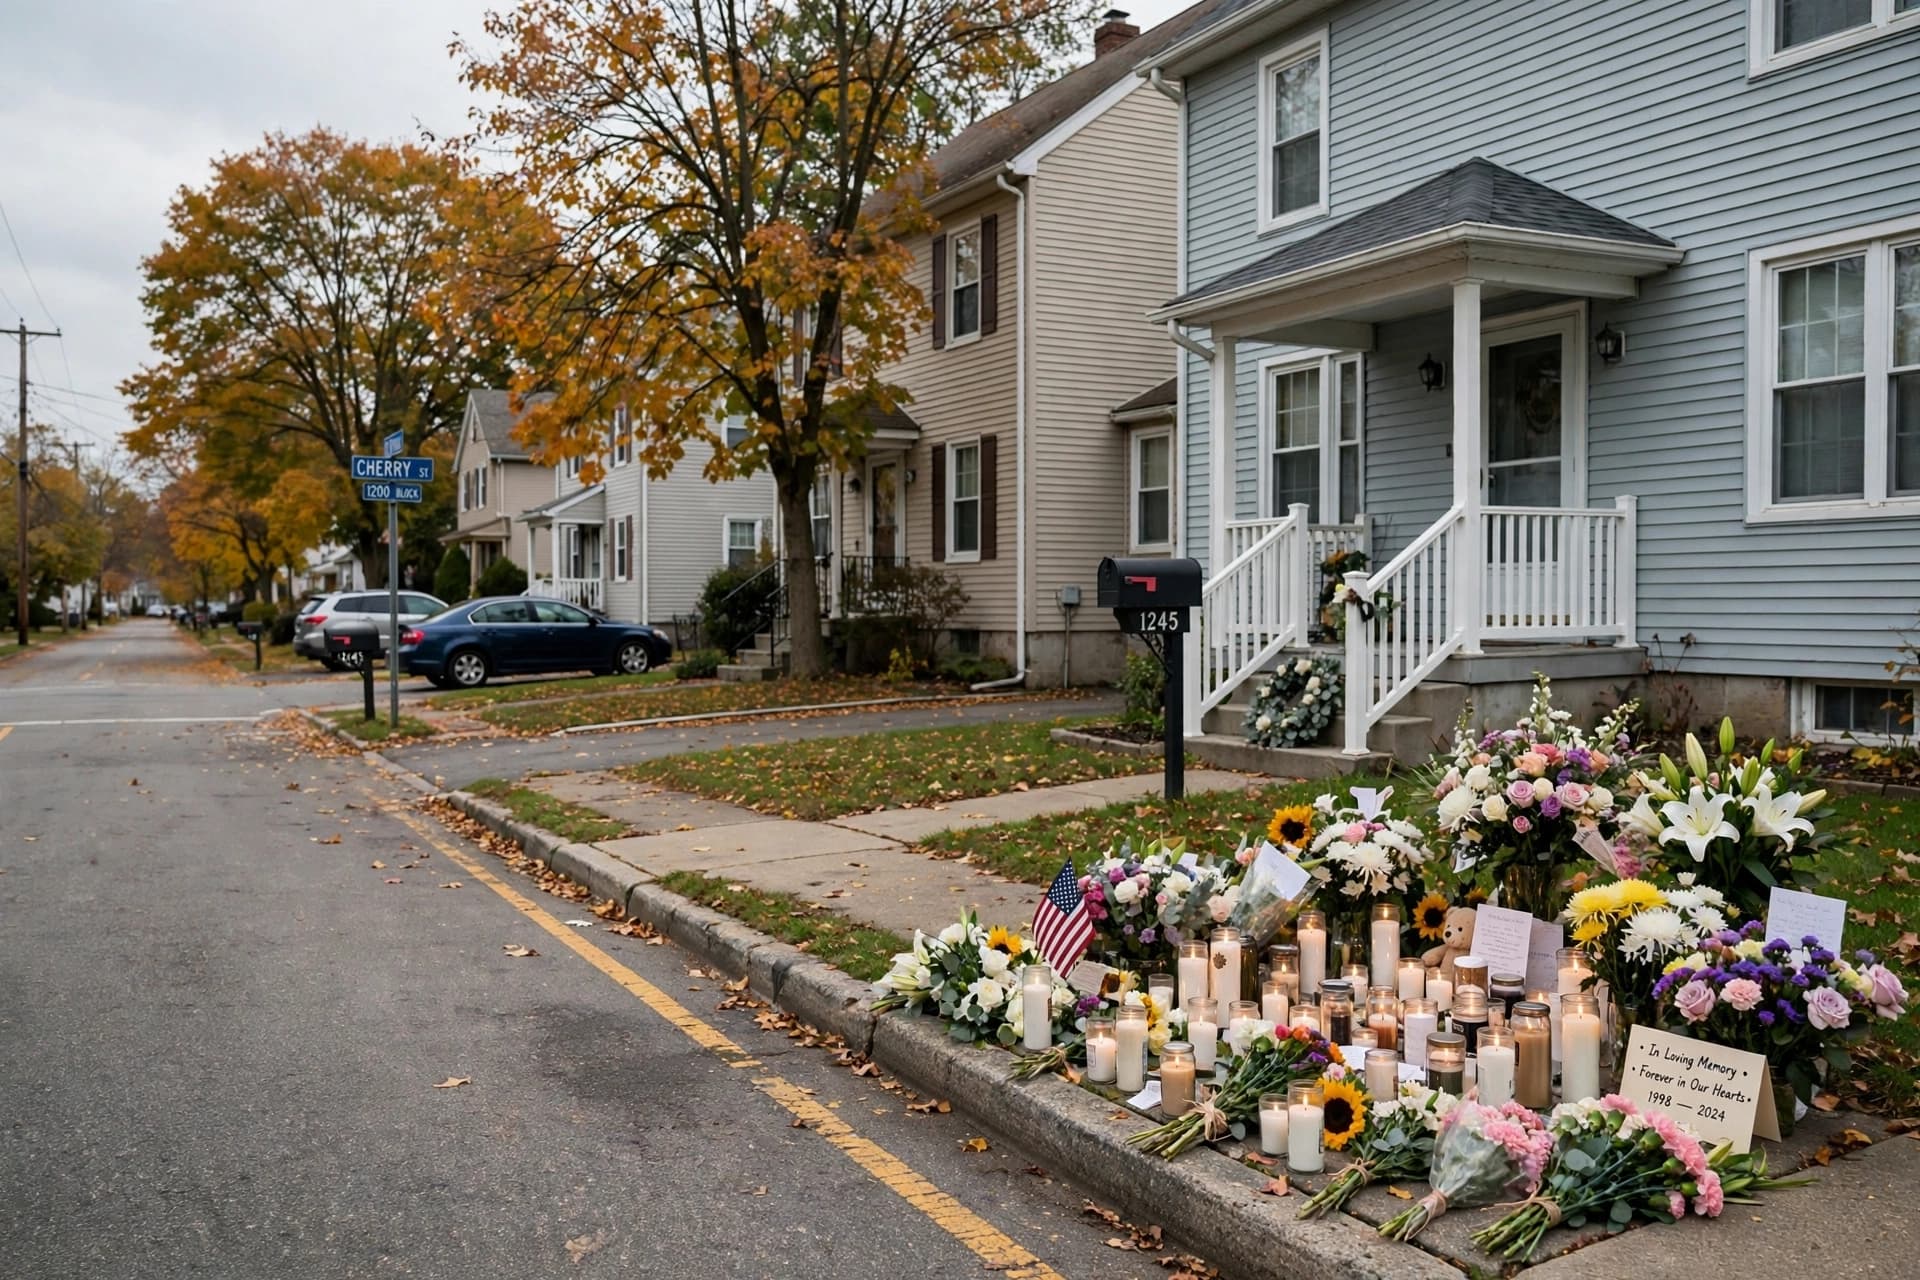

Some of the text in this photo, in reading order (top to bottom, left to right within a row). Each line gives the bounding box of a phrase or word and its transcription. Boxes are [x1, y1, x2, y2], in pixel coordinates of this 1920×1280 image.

[356, 459, 412, 478] CHERRY
[367, 484, 391, 498] 1200
[1140, 611, 1179, 631] 1245
[1648, 1043, 1737, 1081] In Loving Memory
[1639, 1064, 1746, 1103] Forever in Our Hearts
[1648, 1091, 1672, 1107] 1998
[1697, 1104, 1726, 1123] 2024
